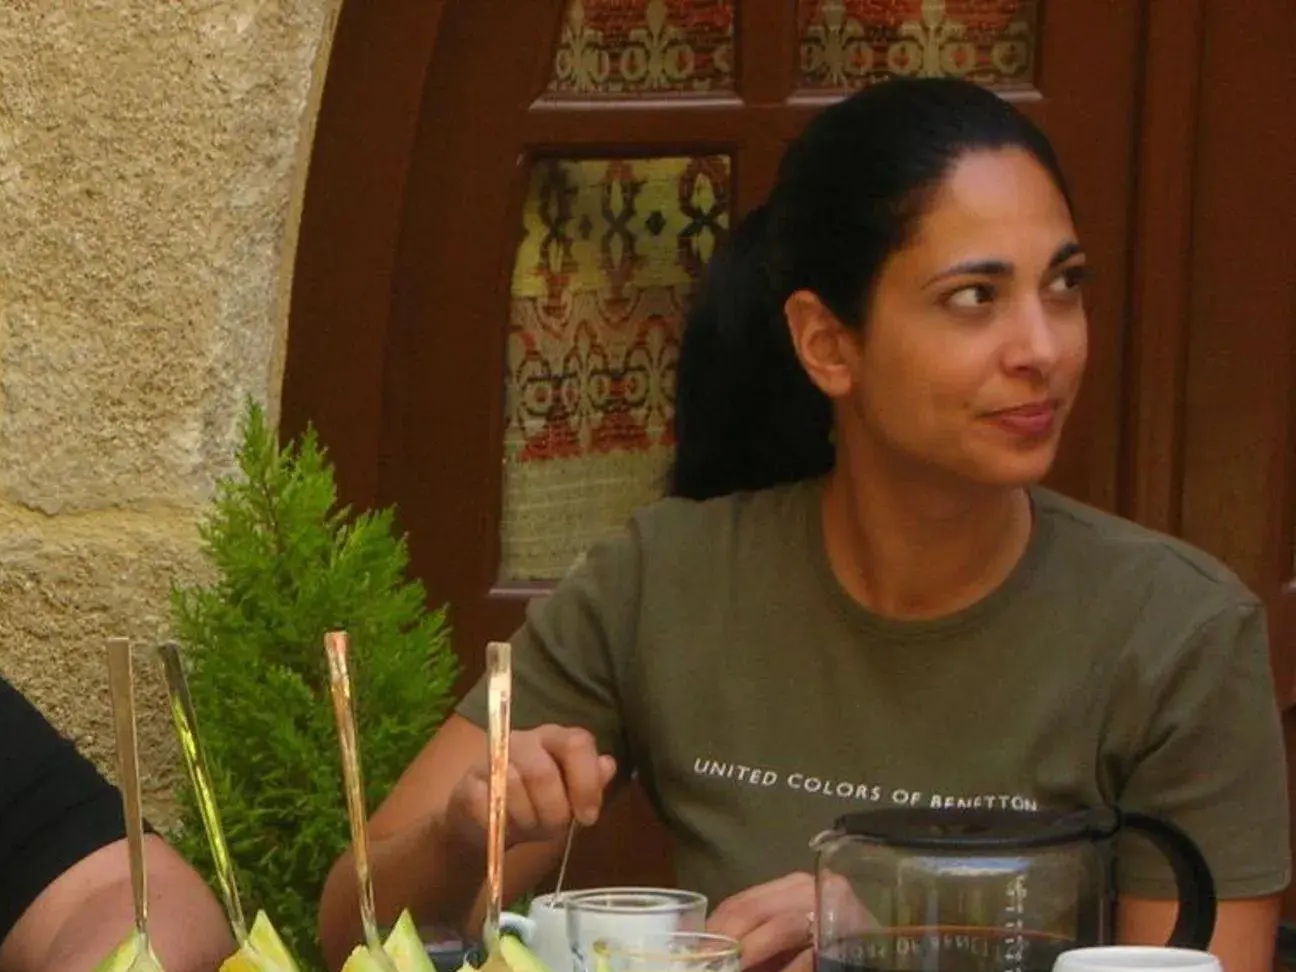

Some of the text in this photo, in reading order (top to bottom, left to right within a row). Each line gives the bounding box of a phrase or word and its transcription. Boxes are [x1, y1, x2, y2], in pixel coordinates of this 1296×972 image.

[693, 757, 778, 787] UNITED
[787, 772, 881, 801] COLORS
[891, 788, 921, 807] OF
